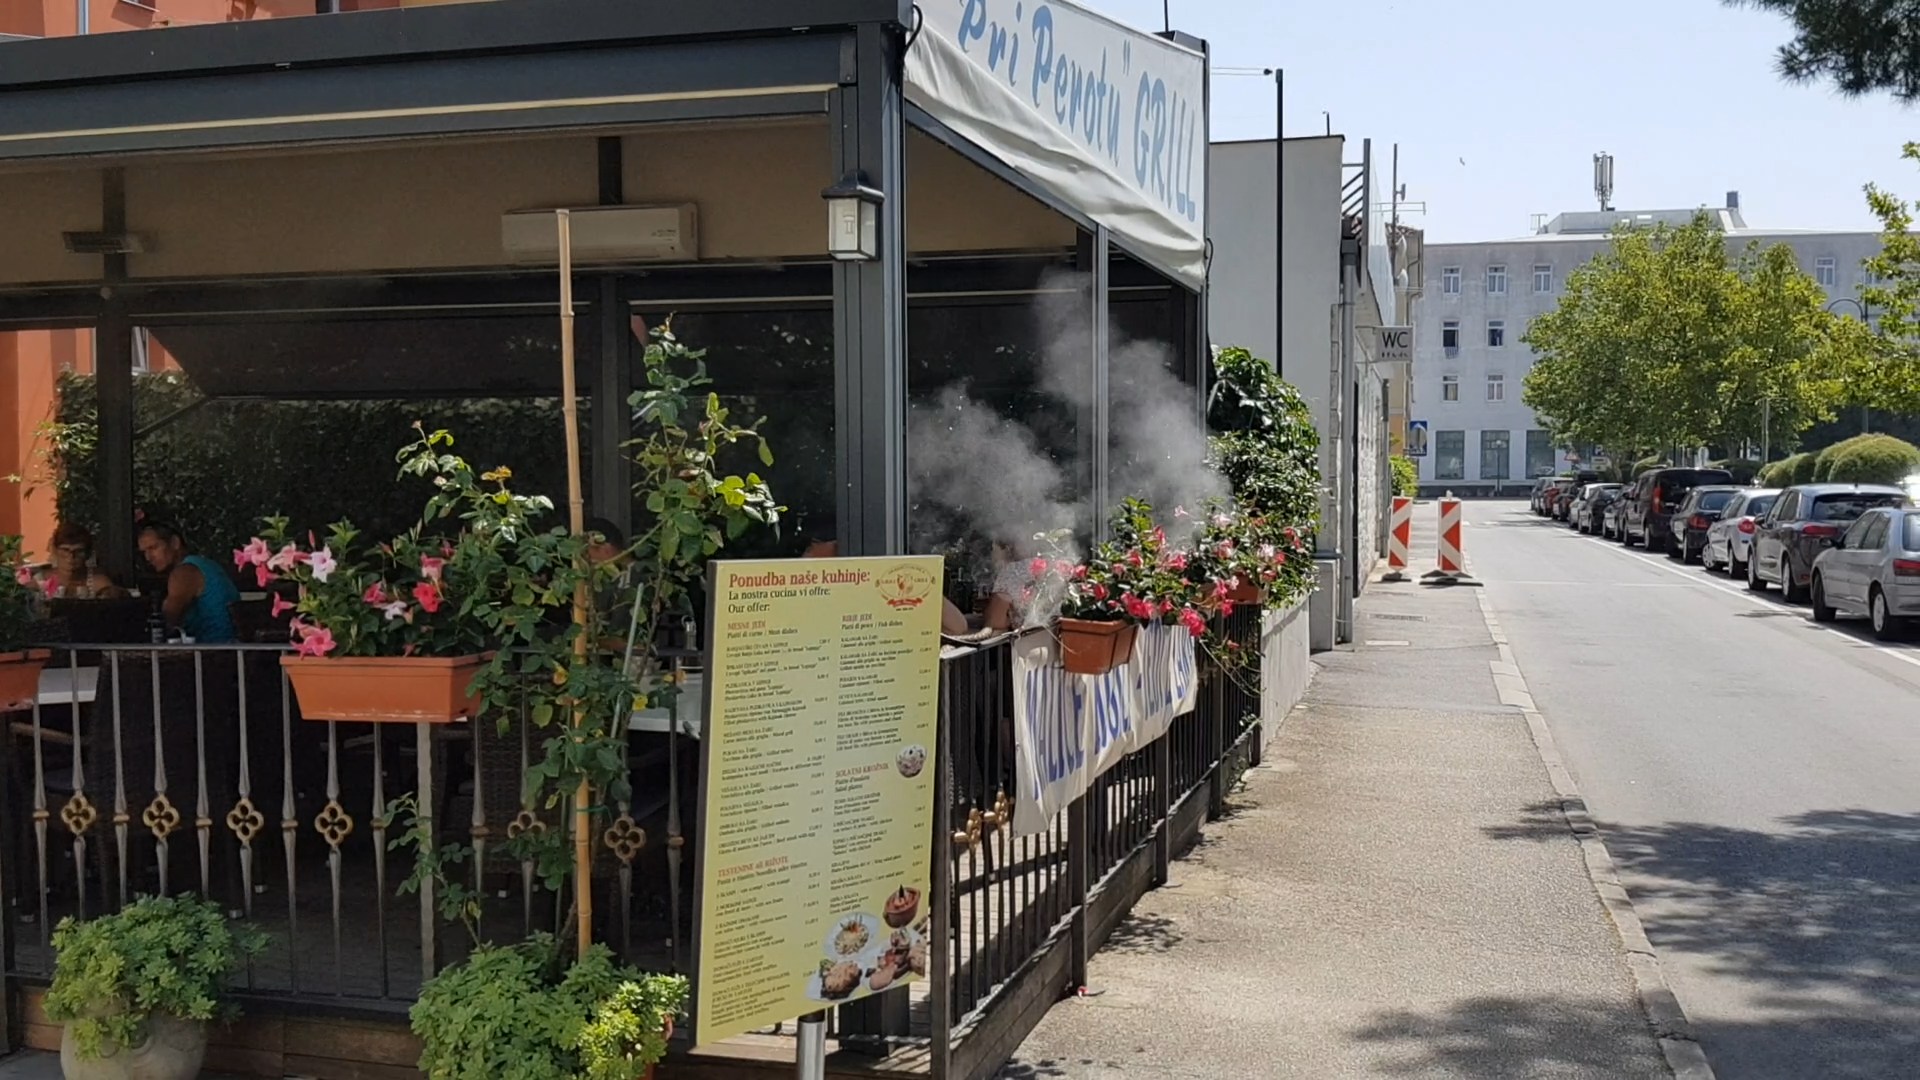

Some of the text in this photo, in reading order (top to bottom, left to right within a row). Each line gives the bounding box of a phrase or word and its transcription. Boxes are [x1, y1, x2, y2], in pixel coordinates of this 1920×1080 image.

[1134, 71, 1196, 222] GRILL
[1382, 331, 1408, 348] WC
[729, 571, 786, 588] Ponudba
[790, 570, 818, 585] naše
[821, 568, 870, 585] kuhinje:
[728, 591, 739, 601] La
[741, 588, 768, 600] nostra
[770, 588, 797, 599] cucina
[799, 586, 807, 597] vi
[728, 602, 770, 614] Our offer:
